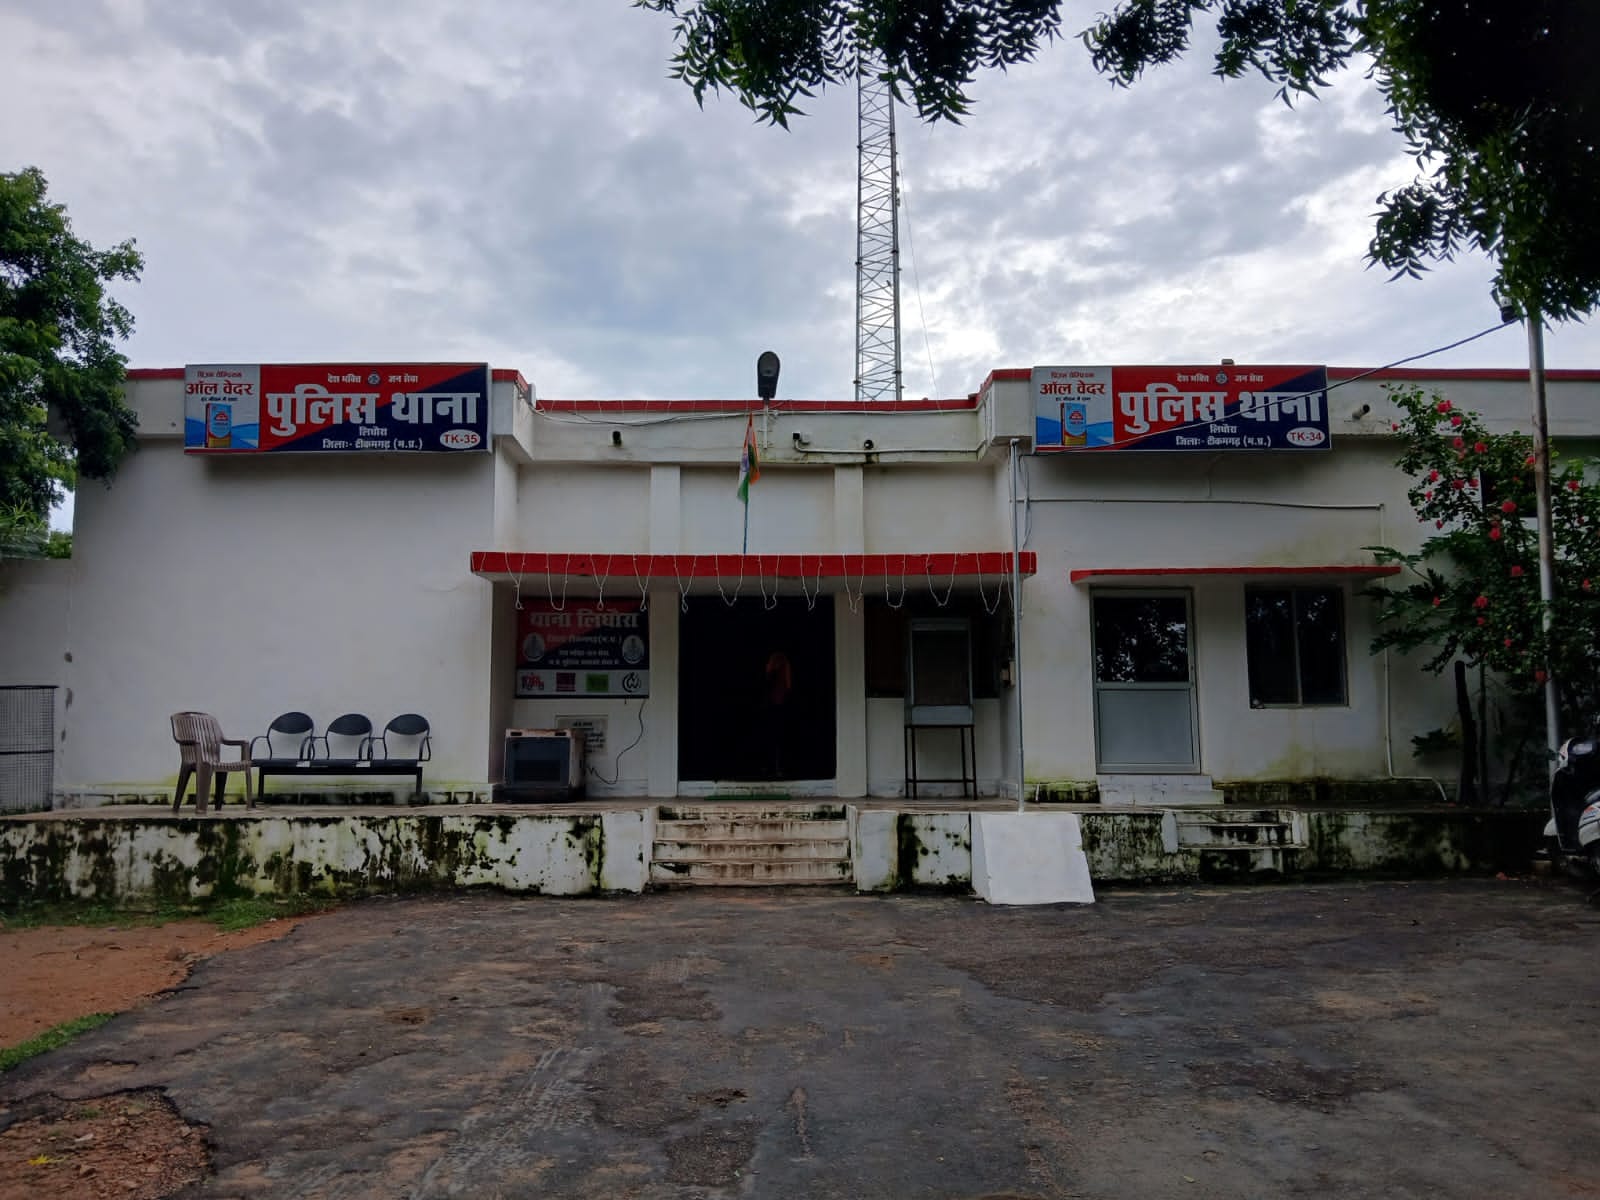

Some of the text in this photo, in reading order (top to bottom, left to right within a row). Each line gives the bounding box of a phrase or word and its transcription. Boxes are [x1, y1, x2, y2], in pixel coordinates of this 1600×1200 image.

[186, 379, 254, 396] ऑल वेदर
[1039, 379, 1106, 395] ऑल वेदर
[265, 383, 481, 437] पुलिस थाना
[1118, 382, 1323, 435] पुलिस थाना
[444, 434, 478, 444] TK-35
[1290, 431, 1322, 441] TK-34
[529, 611, 572, 628] थाना
